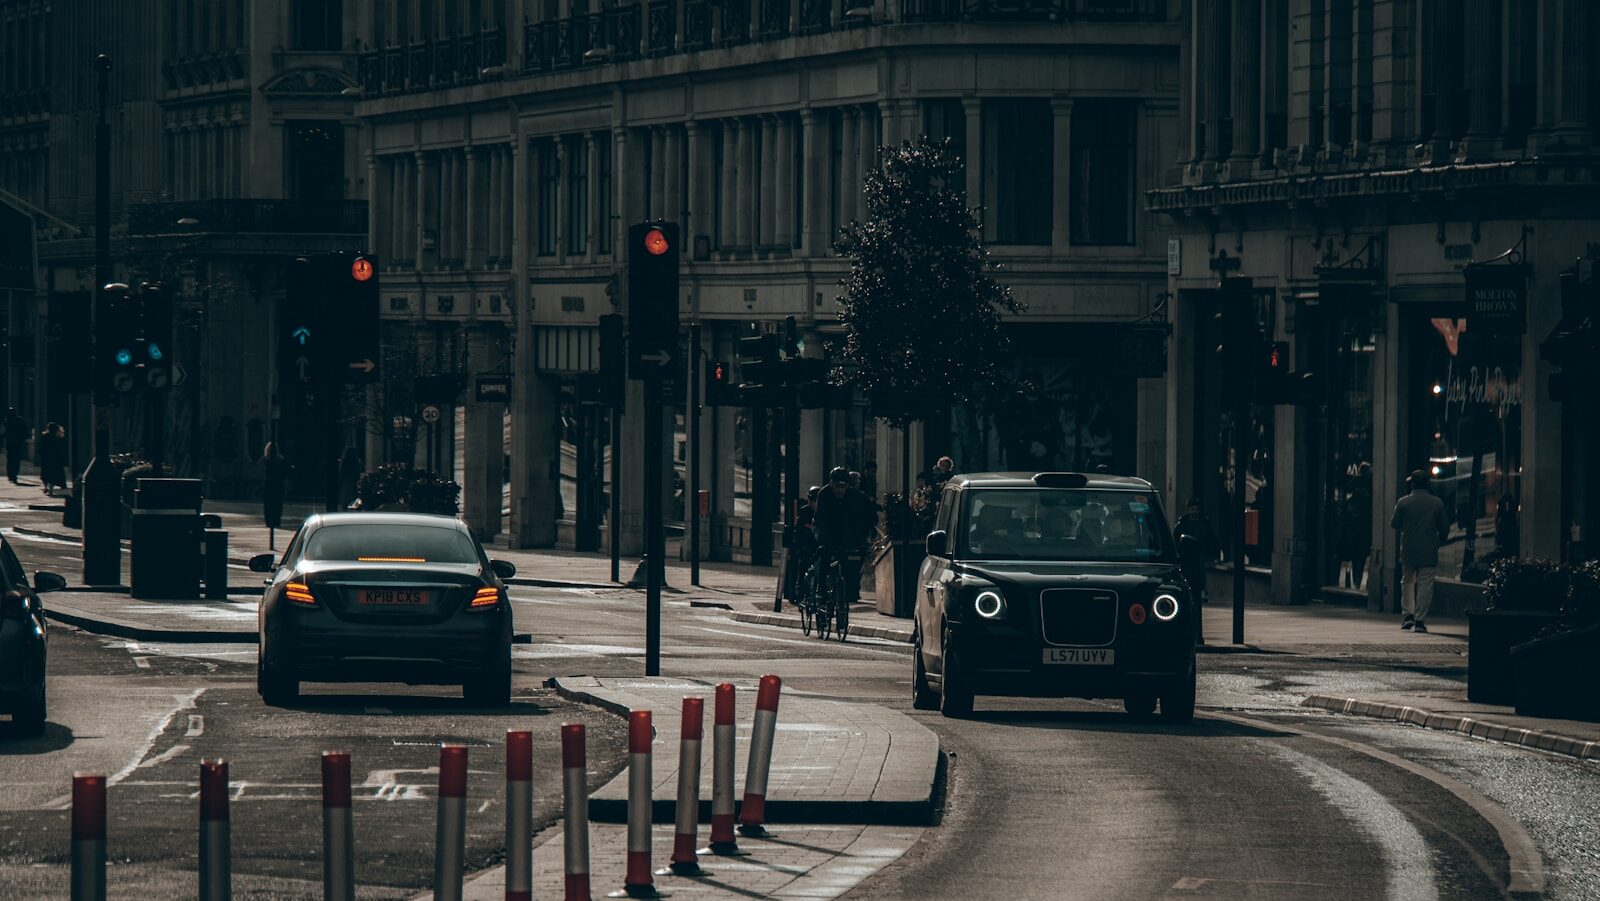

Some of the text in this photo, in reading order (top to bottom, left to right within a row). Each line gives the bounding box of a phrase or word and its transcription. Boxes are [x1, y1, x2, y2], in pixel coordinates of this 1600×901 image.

[1475, 288, 1517, 300] MOLTON
[1475, 301, 1517, 312] BROWN
[424, 410, 437, 418] 20
[366, 591, 421, 604] KP18 CXS
[1050, 650, 1107, 662] LS71 UYV
